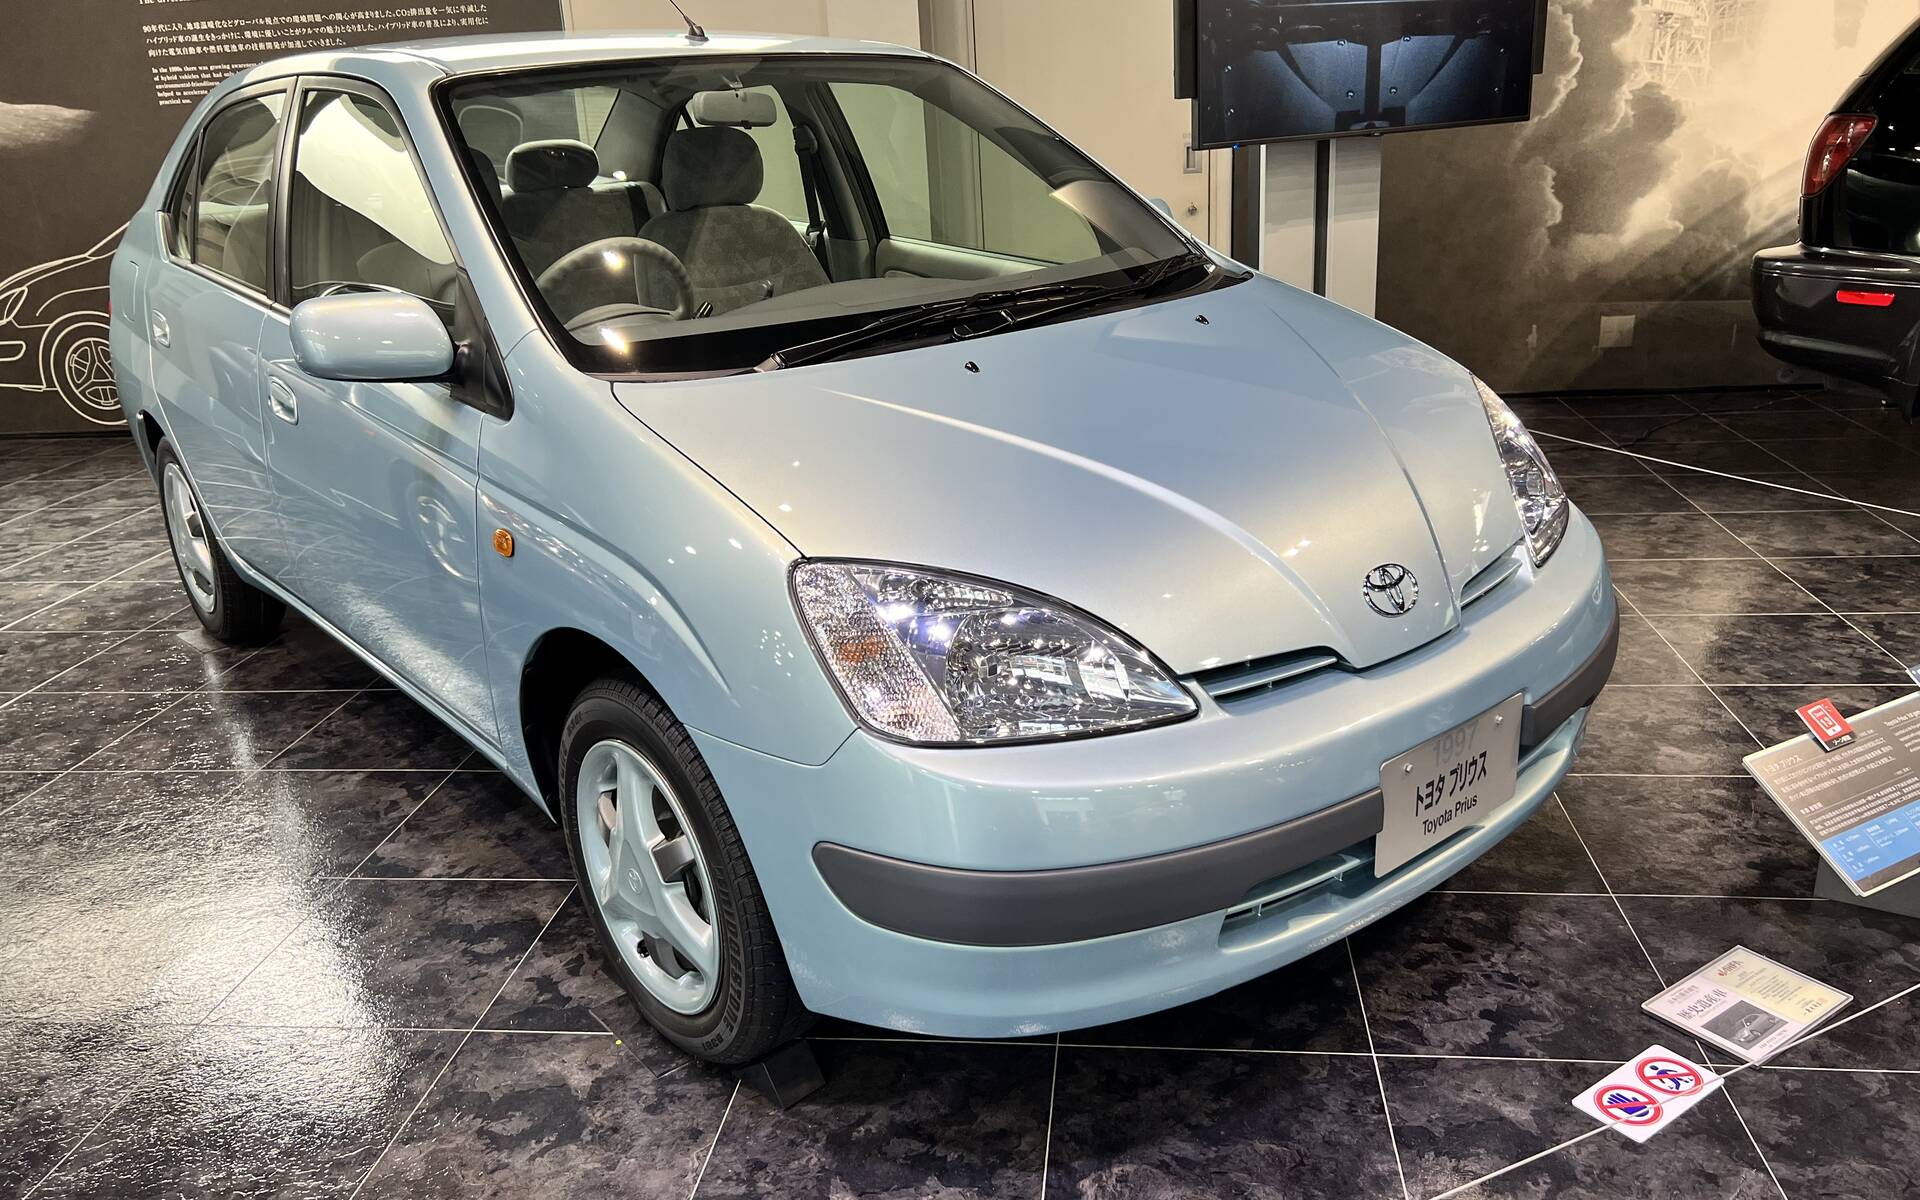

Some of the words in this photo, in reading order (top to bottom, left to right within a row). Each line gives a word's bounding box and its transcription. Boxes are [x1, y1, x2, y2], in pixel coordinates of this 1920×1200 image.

[1434, 721, 1479, 767] 1997
[1416, 774, 1445, 817] トヨタ
[1449, 751, 1487, 797] プリウス
[1423, 809, 1452, 835] Toyota
[1455, 795, 1477, 818] Prius
